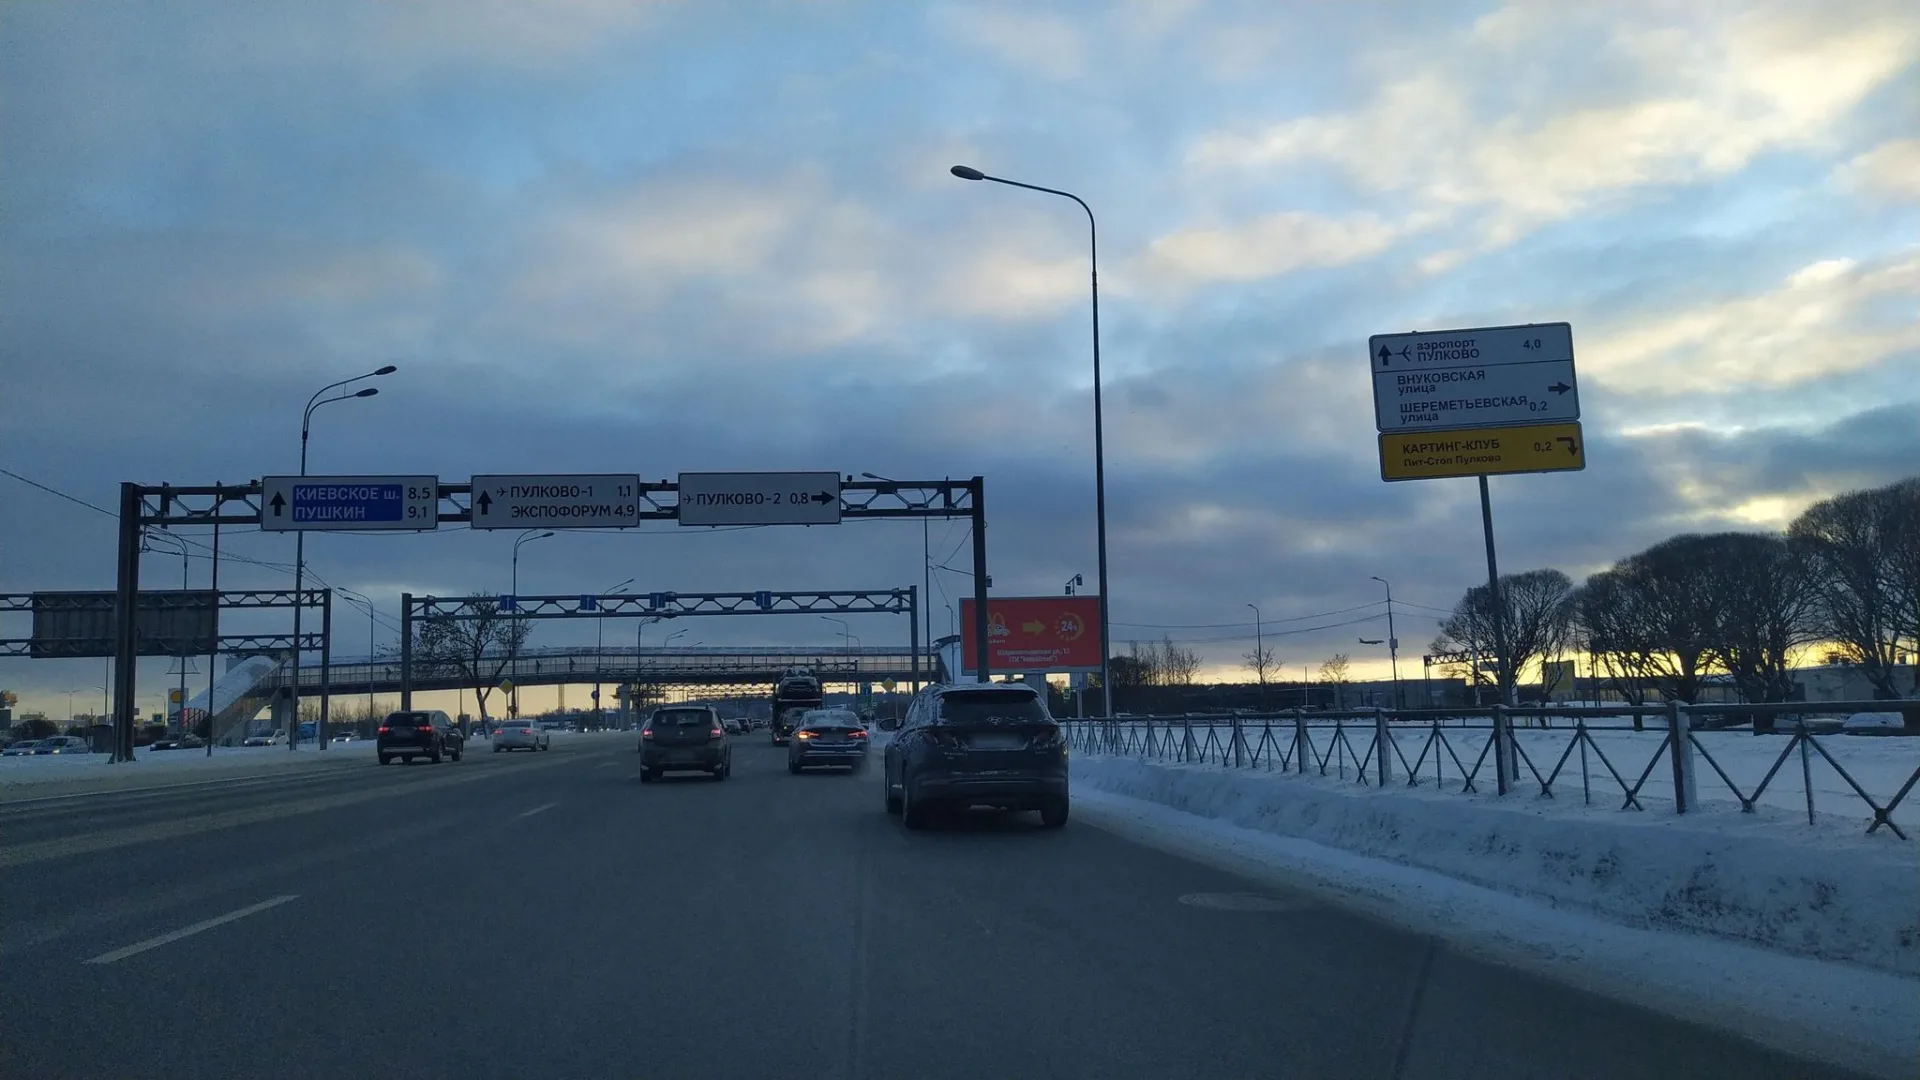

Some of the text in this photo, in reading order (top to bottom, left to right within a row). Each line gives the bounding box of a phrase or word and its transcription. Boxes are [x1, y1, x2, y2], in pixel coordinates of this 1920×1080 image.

[1416, 339, 1476, 352] аэропорт
[1417, 349, 1480, 362] ПУЛКОВО
[1397, 370, 1485, 385] ВНУКОВСКАЯ
[1398, 384, 1436, 396] улица
[1400, 396, 1527, 413] ШЕРЕМЕТЬЕВСКАЯ
[1400, 413, 1439, 425] улица
[1402, 439, 1500, 454] КАРТИНГ-КЛУБ
[1404, 455, 1501, 467] Пит-Стоп Пулково
[295, 487, 431, 500] КИЕВСКОЕ ш. 8,5
[510, 485, 631, 499] ПУЛКОВО-1 1,1
[790, 492, 809, 506] 0,8
[295, 506, 428, 519] ПУШКИН 9,1
[511, 504, 635, 518] ЭКСПОФОРУМ 4,9
